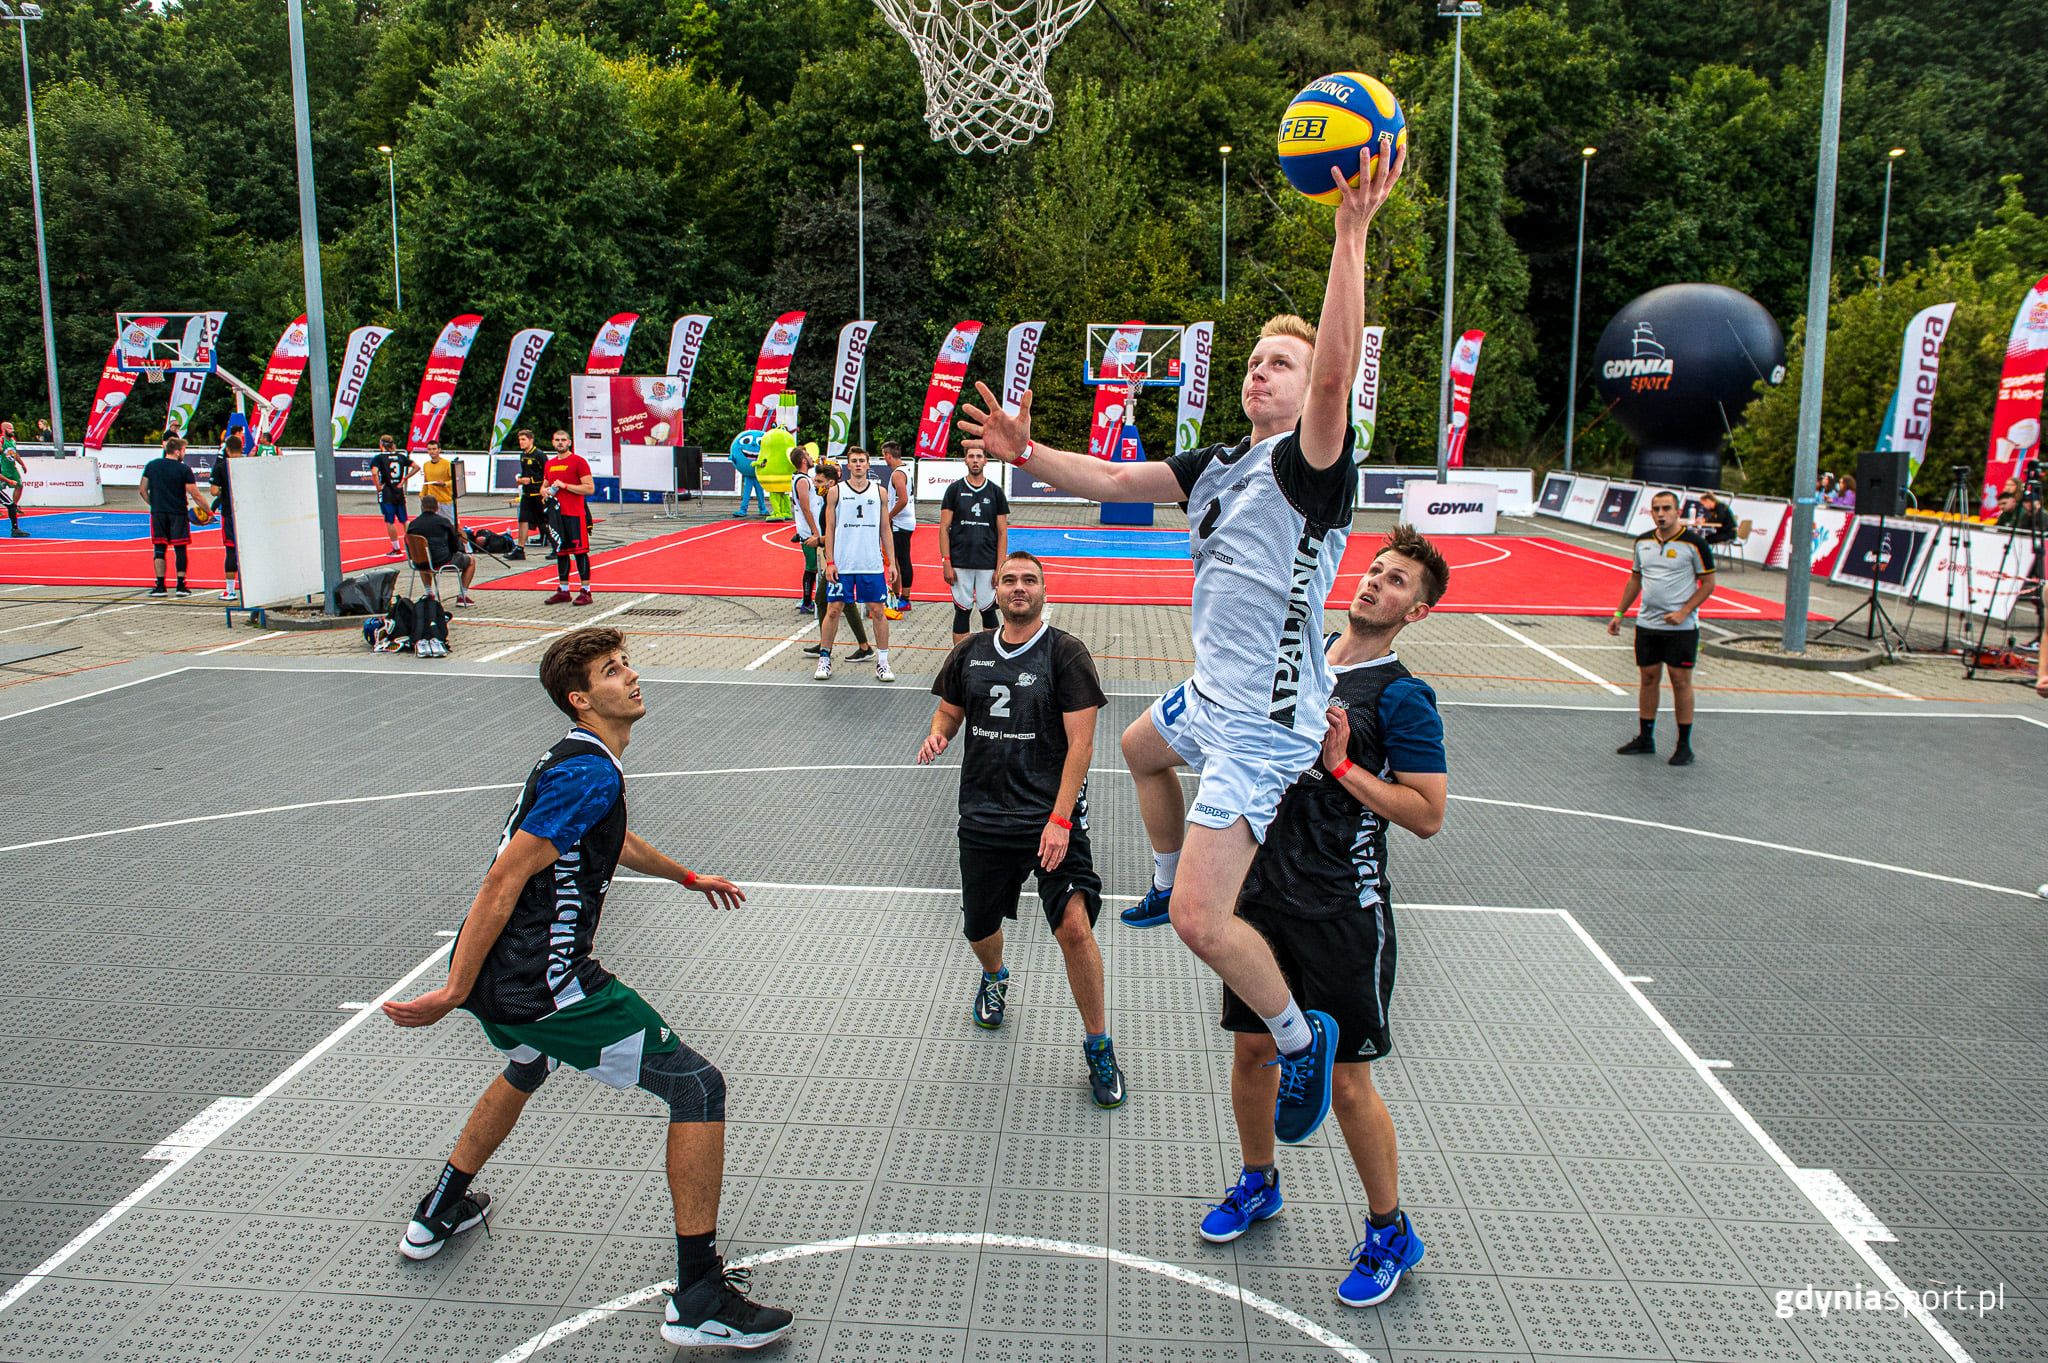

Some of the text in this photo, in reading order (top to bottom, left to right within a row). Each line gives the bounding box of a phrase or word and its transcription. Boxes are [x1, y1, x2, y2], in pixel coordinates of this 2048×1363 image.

[339, 331, 382, 409] Energa
[503, 334, 545, 412] Energa
[834, 326, 868, 405] Energa
[1007, 327, 1039, 407] Energa
[1187, 329, 1212, 409] Energa
[1358, 332, 1381, 411] Energa
[1603, 359, 1674, 380] GDYNIA
[1631, 375, 1673, 393] sport
[1904, 316, 1944, 441] Energa
[389, 461, 401, 478] 3
[603, 486, 611, 500] 1
[642, 491, 650, 501] 3
[856, 504, 864, 519] 1
[971, 502, 981, 517] 4
[1198, 495, 1222, 540] 2
[1427, 502, 1484, 515] GDYNIA
[828, 582, 844, 597] 22
[969, 659, 996, 667] SPALDING
[989, 685, 1011, 718] 2
[978, 727, 999, 740] Energa
